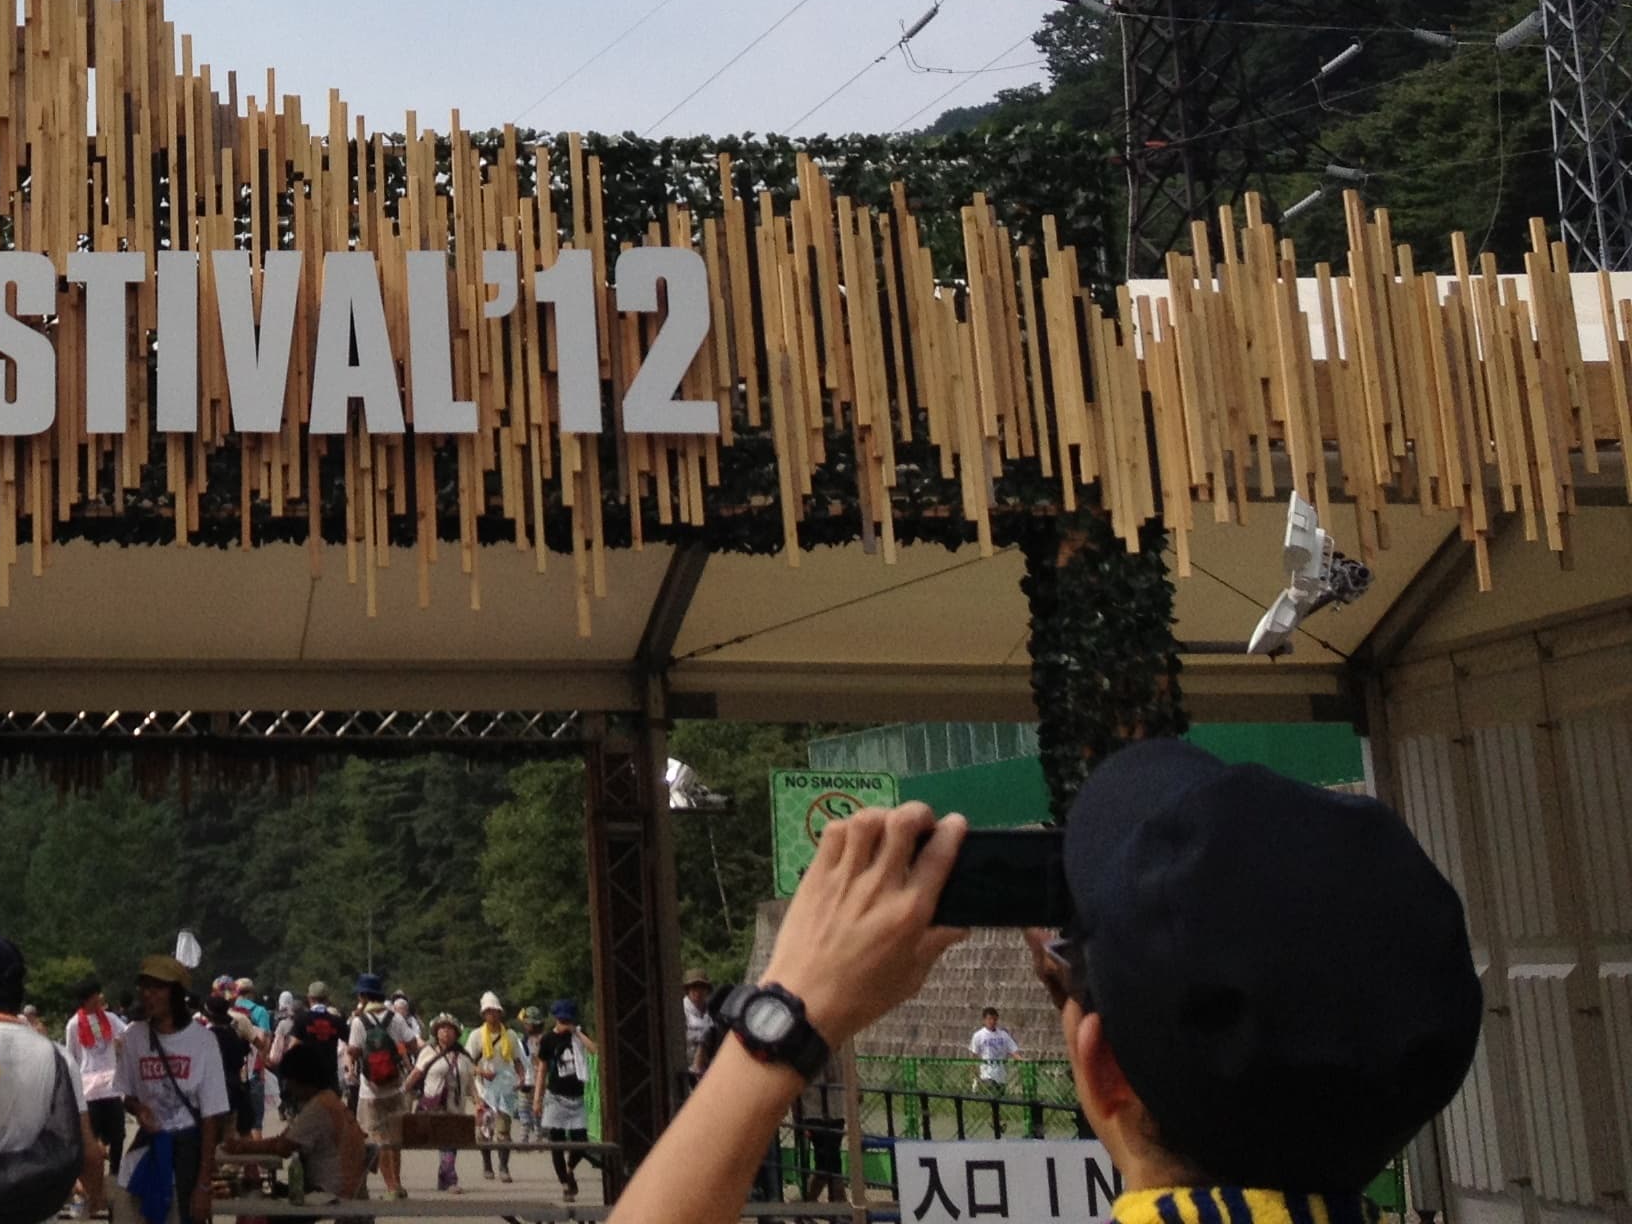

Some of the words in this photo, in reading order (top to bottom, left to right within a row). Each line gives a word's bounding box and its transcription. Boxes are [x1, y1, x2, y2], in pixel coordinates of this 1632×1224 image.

[784, 776, 808, 789] NO
[810, 776, 883, 790] SMOKING
[913, 1157, 1009, 1222] 入口
